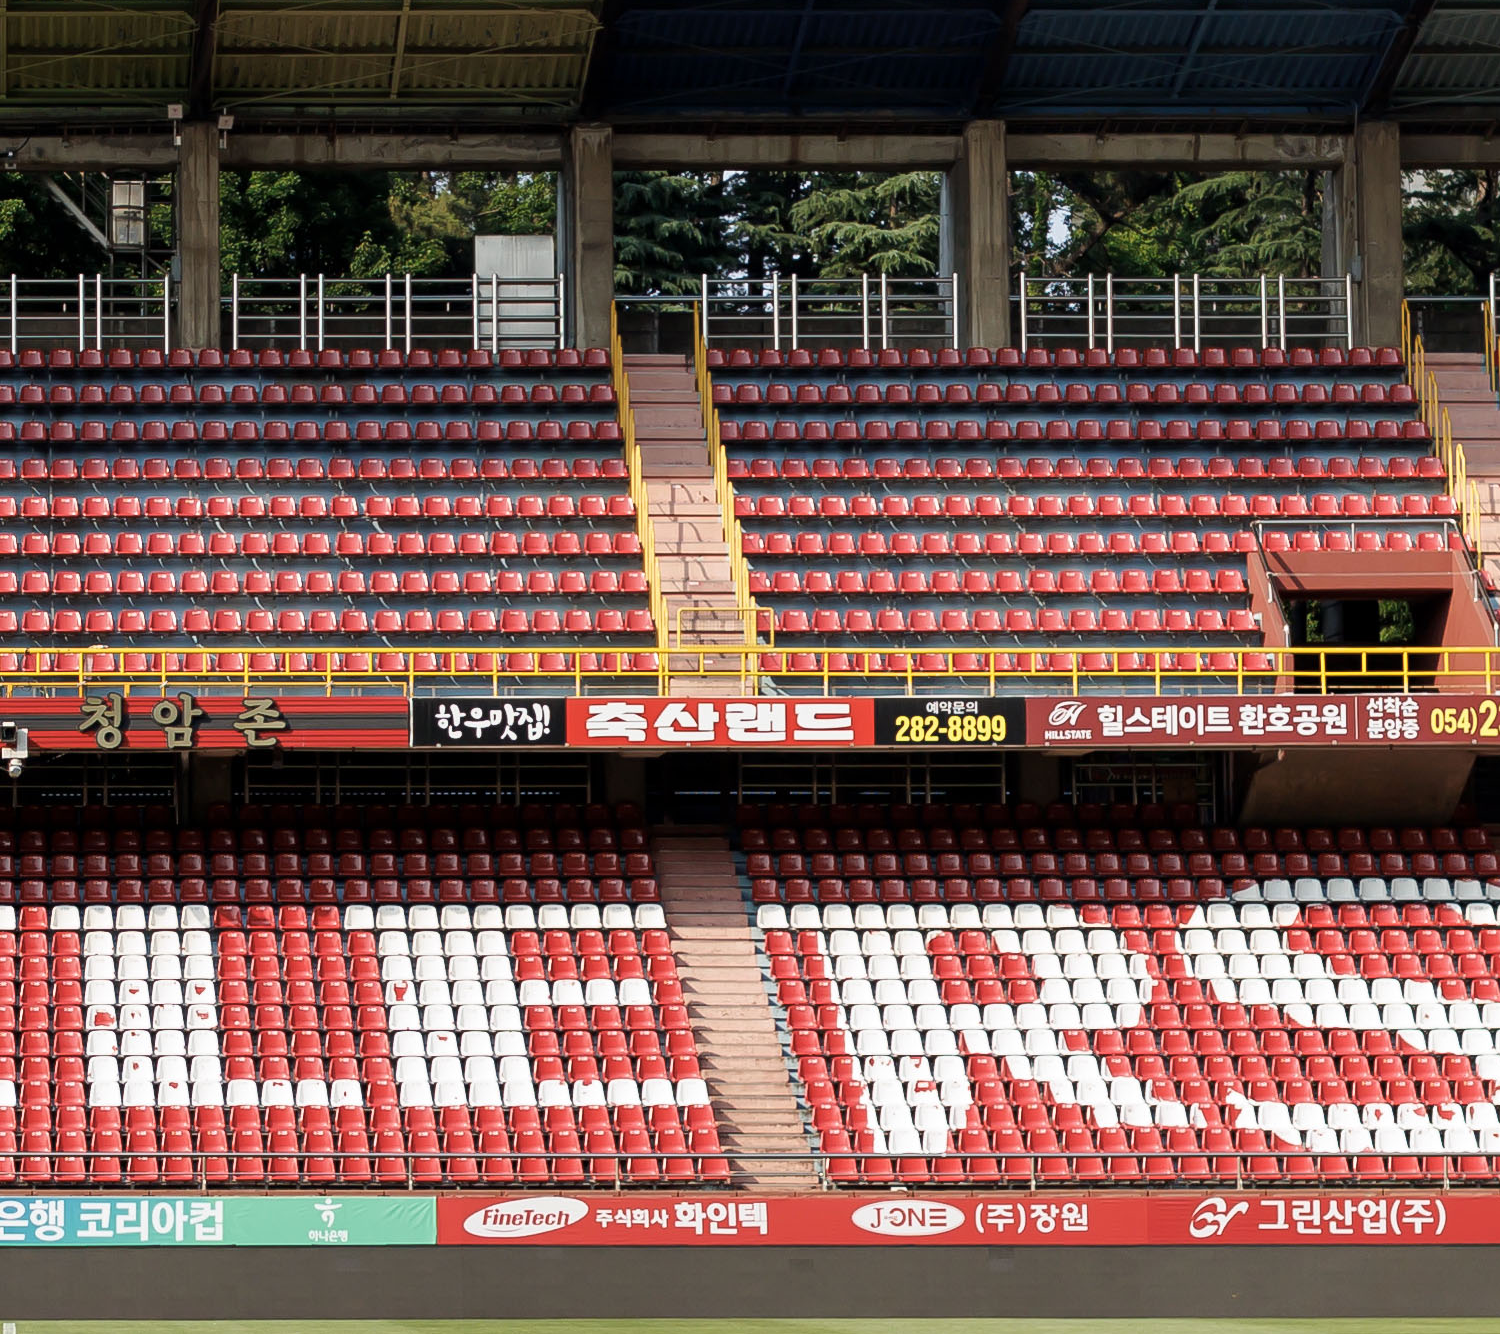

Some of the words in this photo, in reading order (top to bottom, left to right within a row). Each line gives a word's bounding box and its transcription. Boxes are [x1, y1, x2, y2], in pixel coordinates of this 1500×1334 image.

[79, 692, 287, 750] 청암존
[435, 703, 551, 741] 한우맛집!
[585, 701, 855, 743] 축산랜드
[926, 700, 979, 715] 예약문의
[1097, 704, 1233, 737] 힐스테이트
[1238, 703, 1348, 736] 환호공원
[1366, 697, 1419, 719] 선착순
[895, 715, 1007, 743] 282-8899
[1044, 729, 1092, 740] HILLSTATE
[1366, 718, 1419, 740] 분양중
[76, 1199, 224, 1242] 코리아컵
[482, 1208, 572, 1227] FineTech
[595, 1207, 669, 1229] 주식회사
[674, 1201, 768, 1236] 화인텍
[974, 1202, 1089, 1234] (주)장원
[1258, 1199, 1447, 1236] 그린산업(주)
